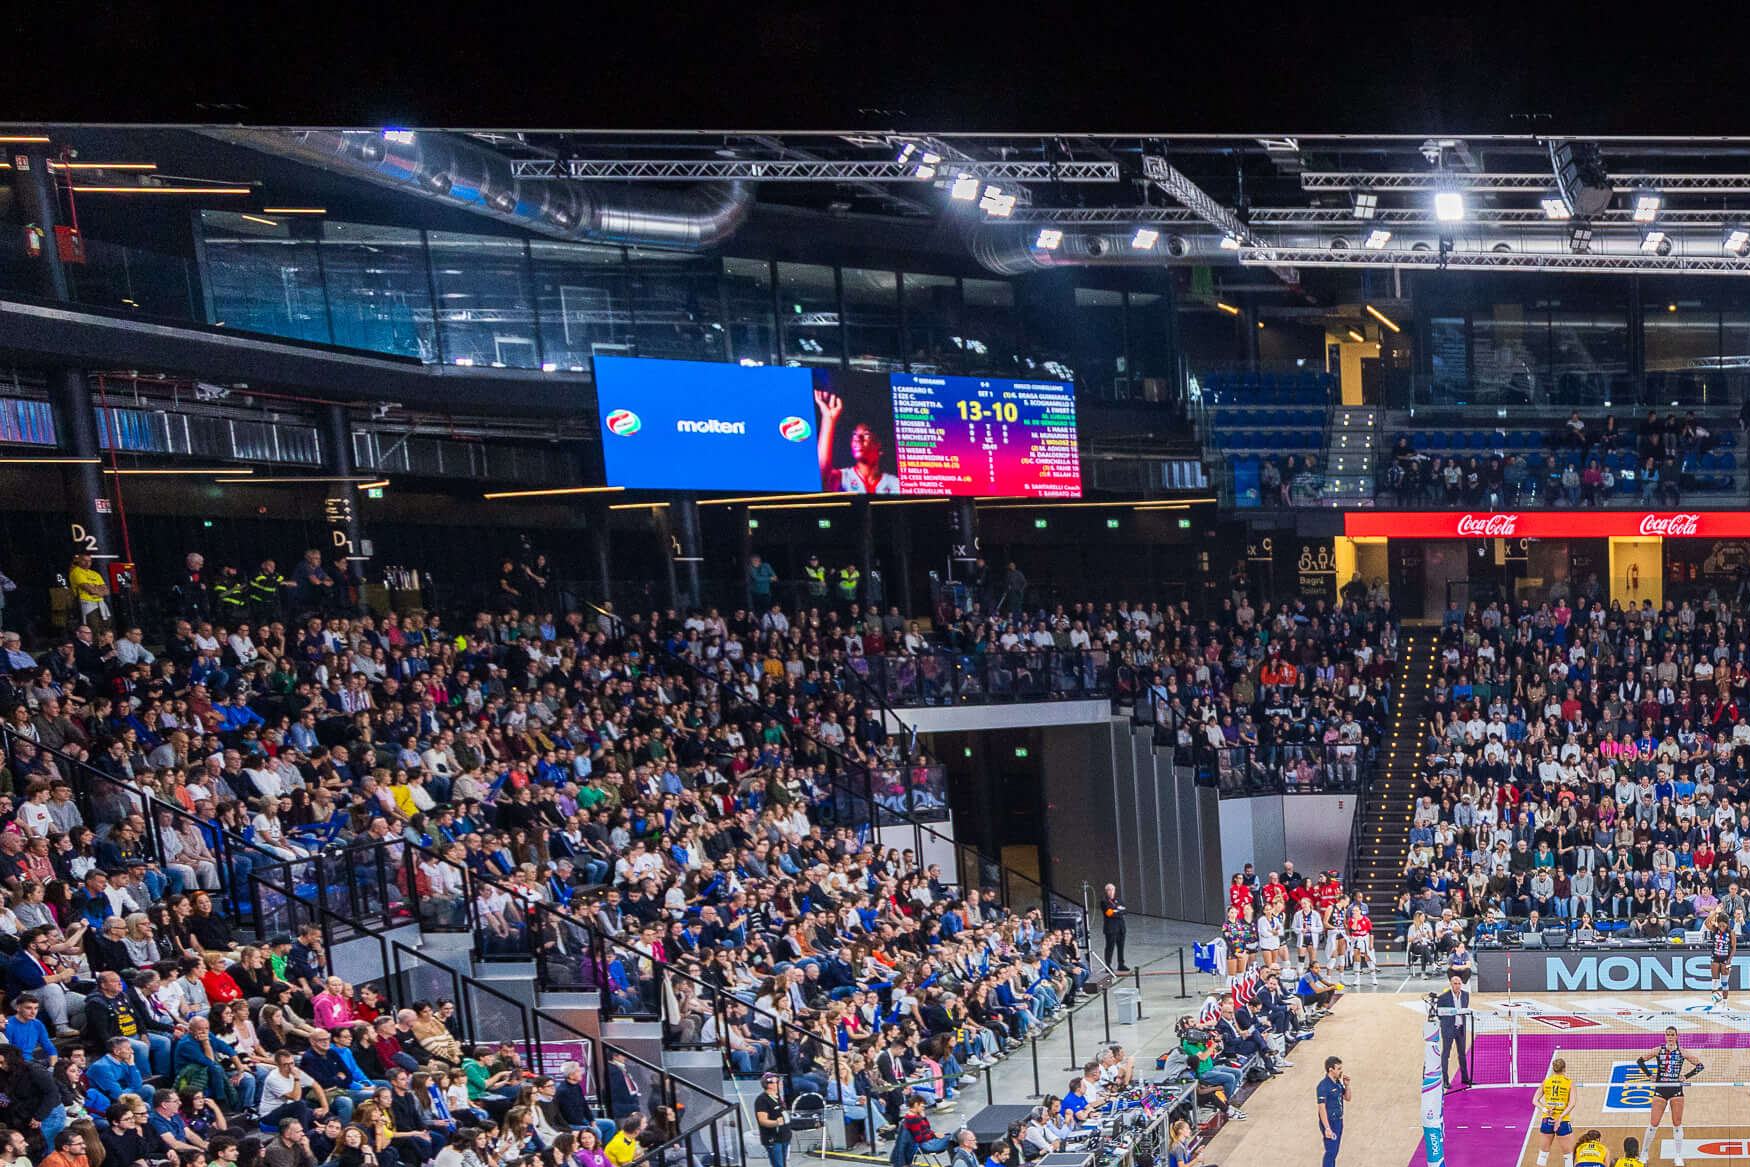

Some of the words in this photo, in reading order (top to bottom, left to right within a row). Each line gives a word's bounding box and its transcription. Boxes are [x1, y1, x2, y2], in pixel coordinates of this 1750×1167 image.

[956, 400, 1018, 422] 13-10
[677, 419, 746, 434] molten
[1551, 1085, 1559, 1097] 14
